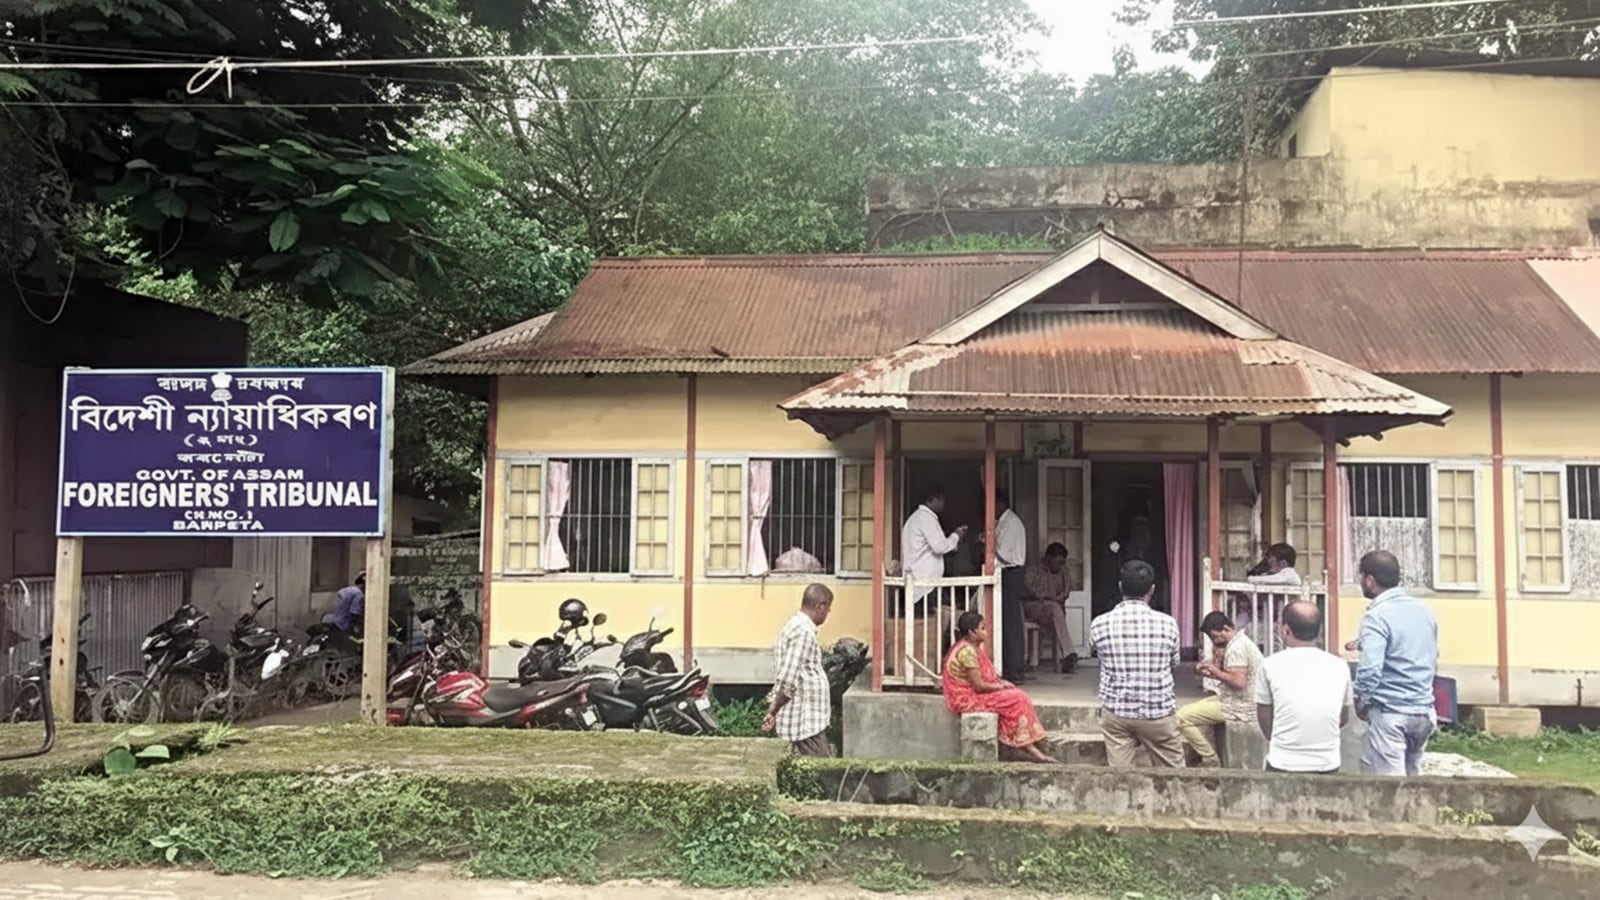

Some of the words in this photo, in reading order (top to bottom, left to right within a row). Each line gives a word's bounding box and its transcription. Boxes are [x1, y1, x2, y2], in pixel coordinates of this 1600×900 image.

[69, 394, 175, 431] বিদেশী
[136, 469, 196, 481] GOVT.
[202, 469, 229, 480] OF
[232, 469, 304, 480] ASSAM
[63, 482, 235, 508] FOREIGNERS'
[243, 481, 378, 507] TRIBUNAL
